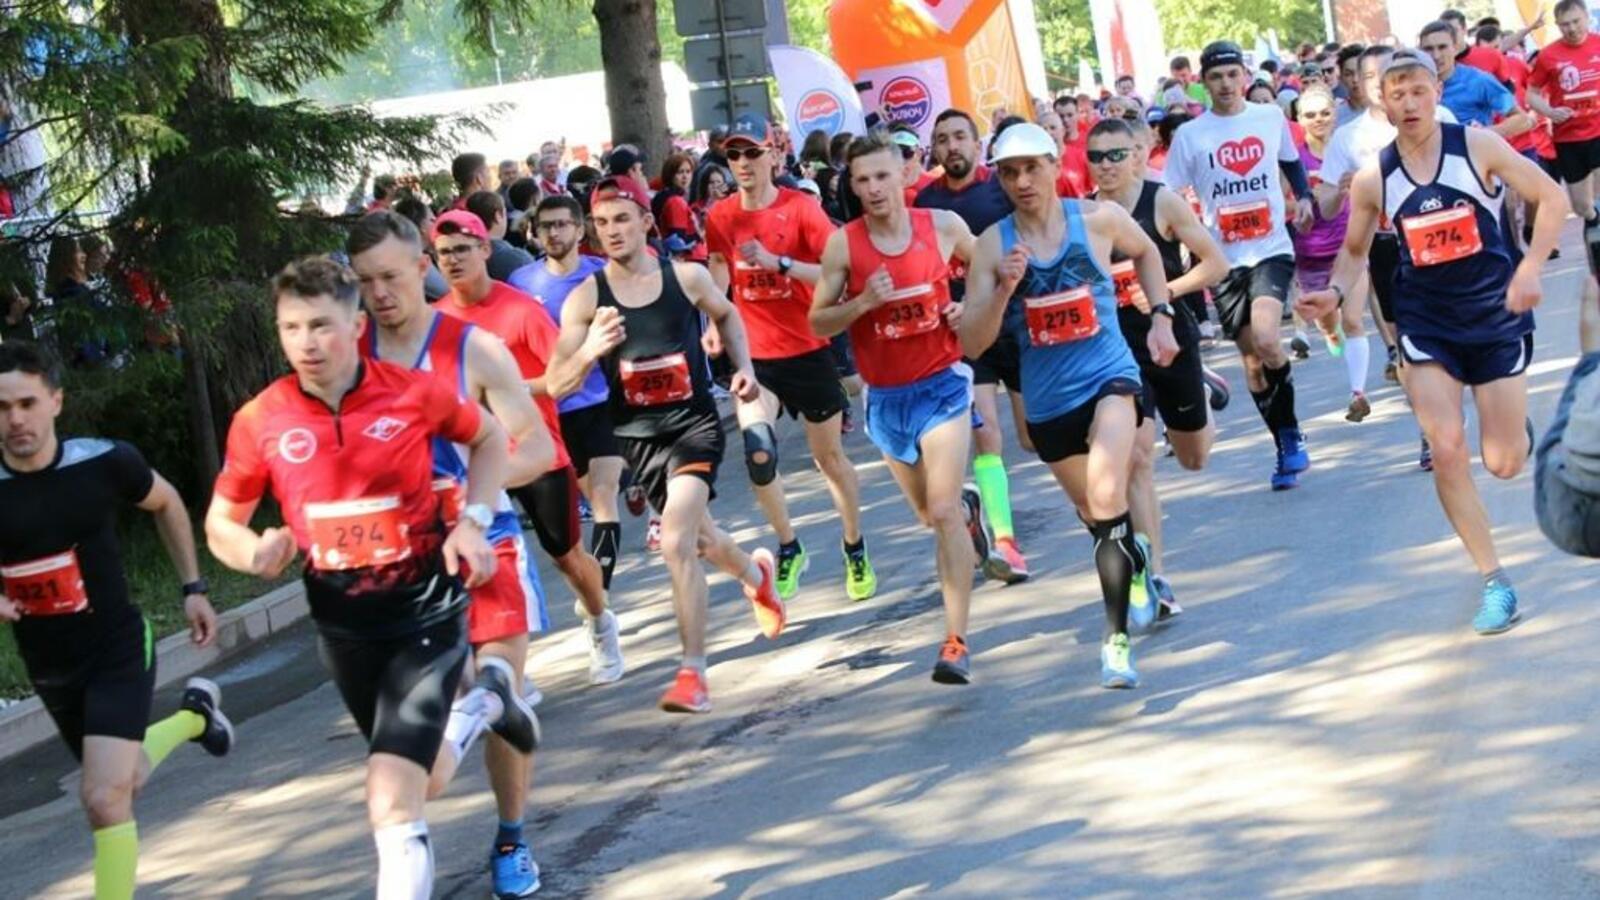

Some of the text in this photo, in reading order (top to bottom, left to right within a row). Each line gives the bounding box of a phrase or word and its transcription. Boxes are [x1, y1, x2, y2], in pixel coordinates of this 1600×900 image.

[1208, 143, 1263, 170] I Run
[1424, 226, 1463, 249] 274
[1044, 307, 1081, 330] 275
[641, 372, 675, 392] 257
[334, 522, 384, 547] 294
